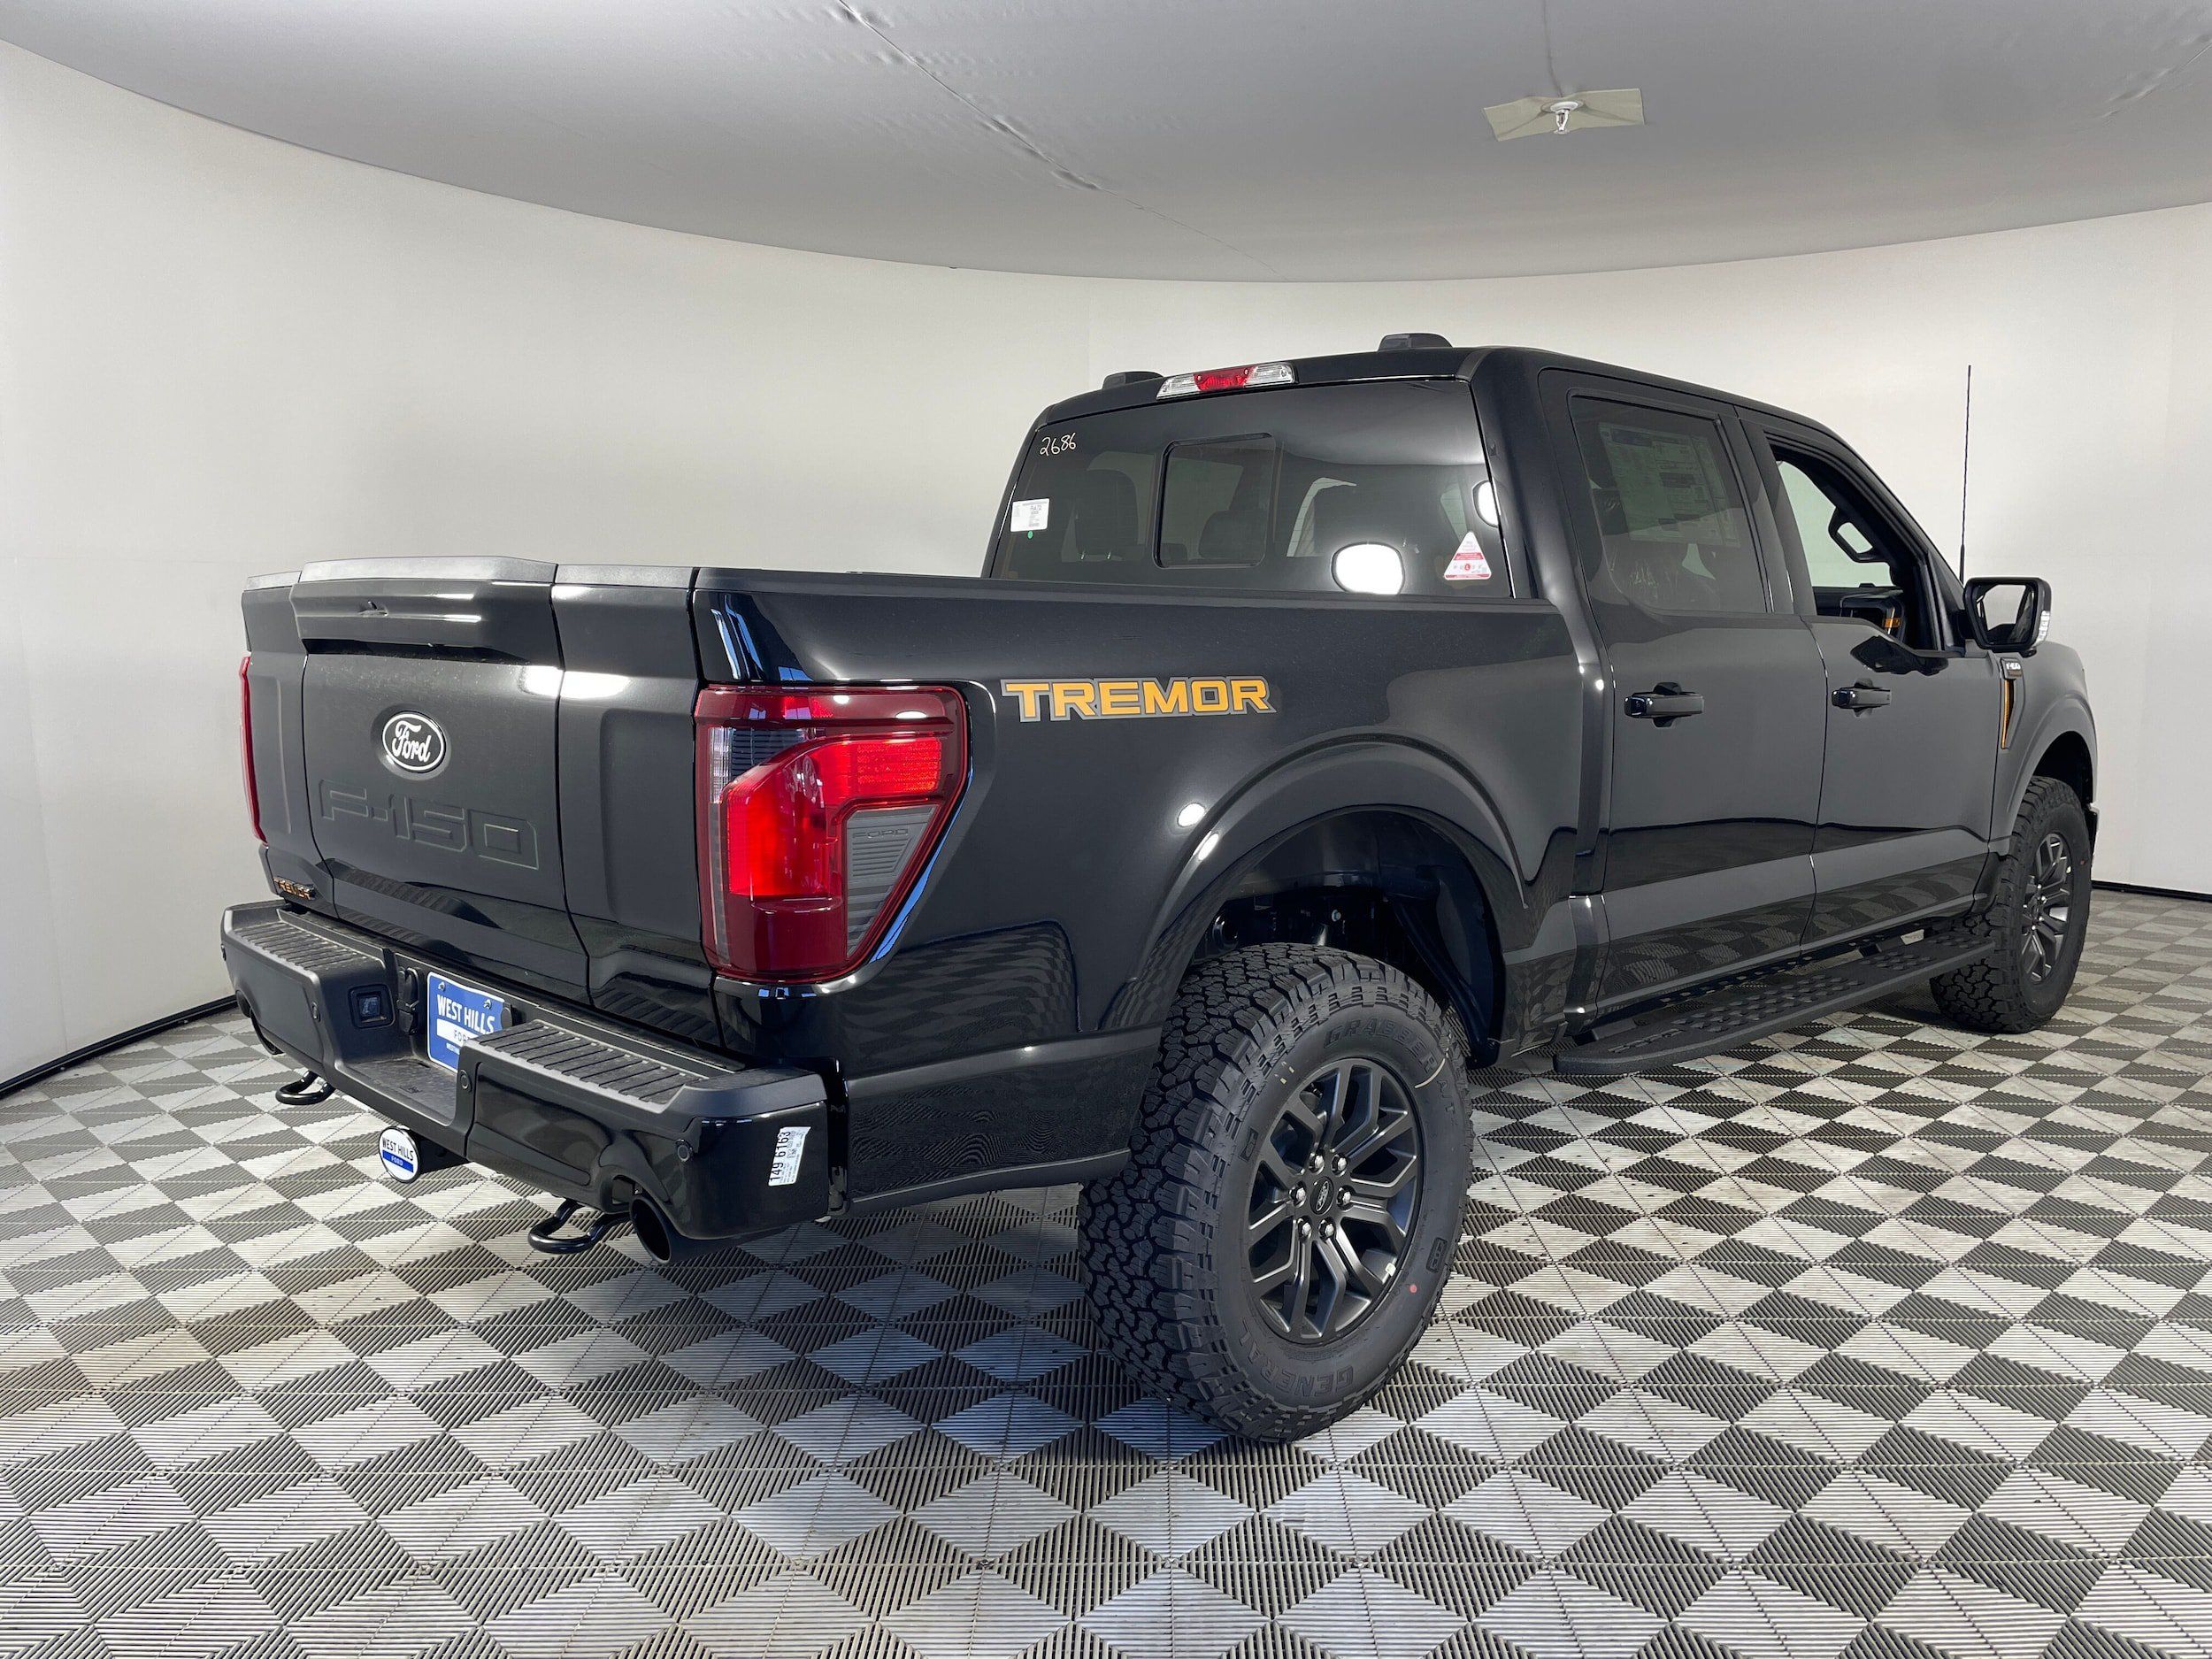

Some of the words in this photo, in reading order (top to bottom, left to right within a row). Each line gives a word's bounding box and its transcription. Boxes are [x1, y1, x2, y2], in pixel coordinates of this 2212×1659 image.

[1040, 433, 1076, 456] 2686
[1002, 677, 1276, 723] TREMOR
[391, 719, 433, 763] Ford
[319, 779, 540, 871] F-150
[852, 828, 909, 840] FORD
[436, 994, 463, 1023] WEST
[464, 1007, 495, 1035] HILLS
[1324, 1018, 1438, 1074] GRABBER
[382, 1136, 396, 1152] WEST
[397, 1145, 413, 1161] HILLS
[774, 1131, 791, 1158] 6163
[770, 1162, 784, 1182] 149
[1240, 1317, 1354, 1397] GENERAL
